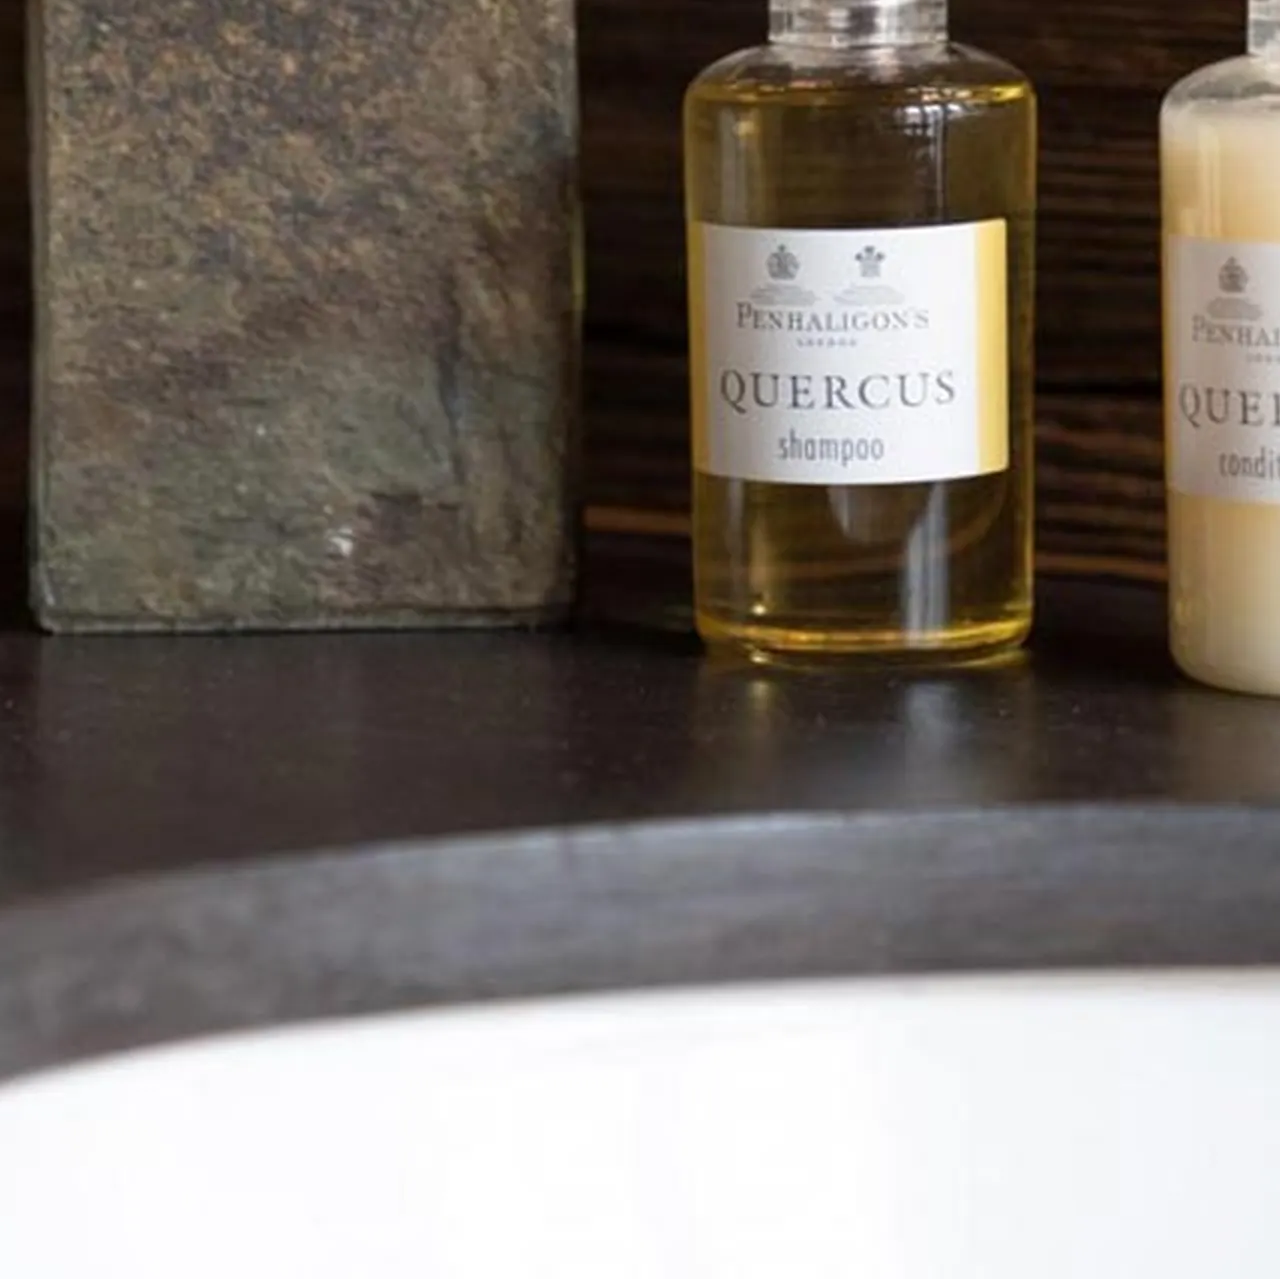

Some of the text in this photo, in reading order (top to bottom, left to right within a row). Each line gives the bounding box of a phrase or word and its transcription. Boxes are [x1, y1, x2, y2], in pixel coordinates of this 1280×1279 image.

[736, 301, 930, 332] PENHALIGON'S
[720, 369, 956, 414] QUERCUS
[777, 428, 885, 467] shampoo
